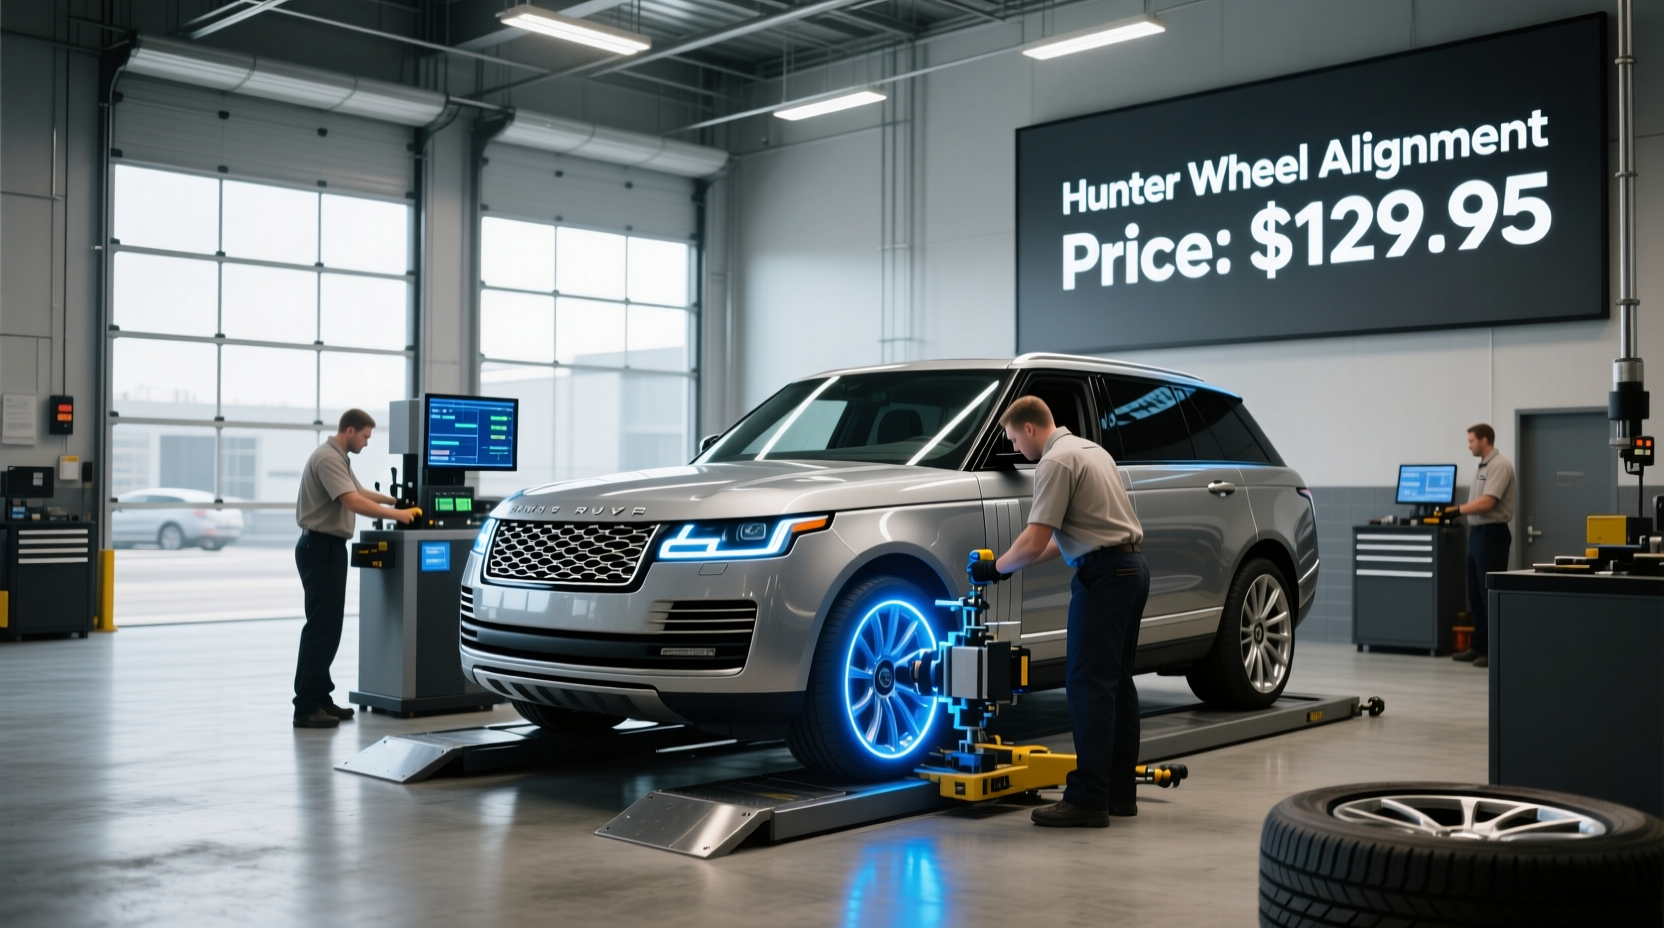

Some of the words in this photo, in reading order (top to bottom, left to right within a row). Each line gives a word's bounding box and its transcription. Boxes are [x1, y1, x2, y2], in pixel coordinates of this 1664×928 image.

[1062, 171, 1181, 216] Hunter
[1187, 143, 1309, 197] Wheel
[1318, 109, 1549, 180] Alignment
[1062, 222, 1232, 291] Price:
[1250, 171, 1552, 280] $129.95
